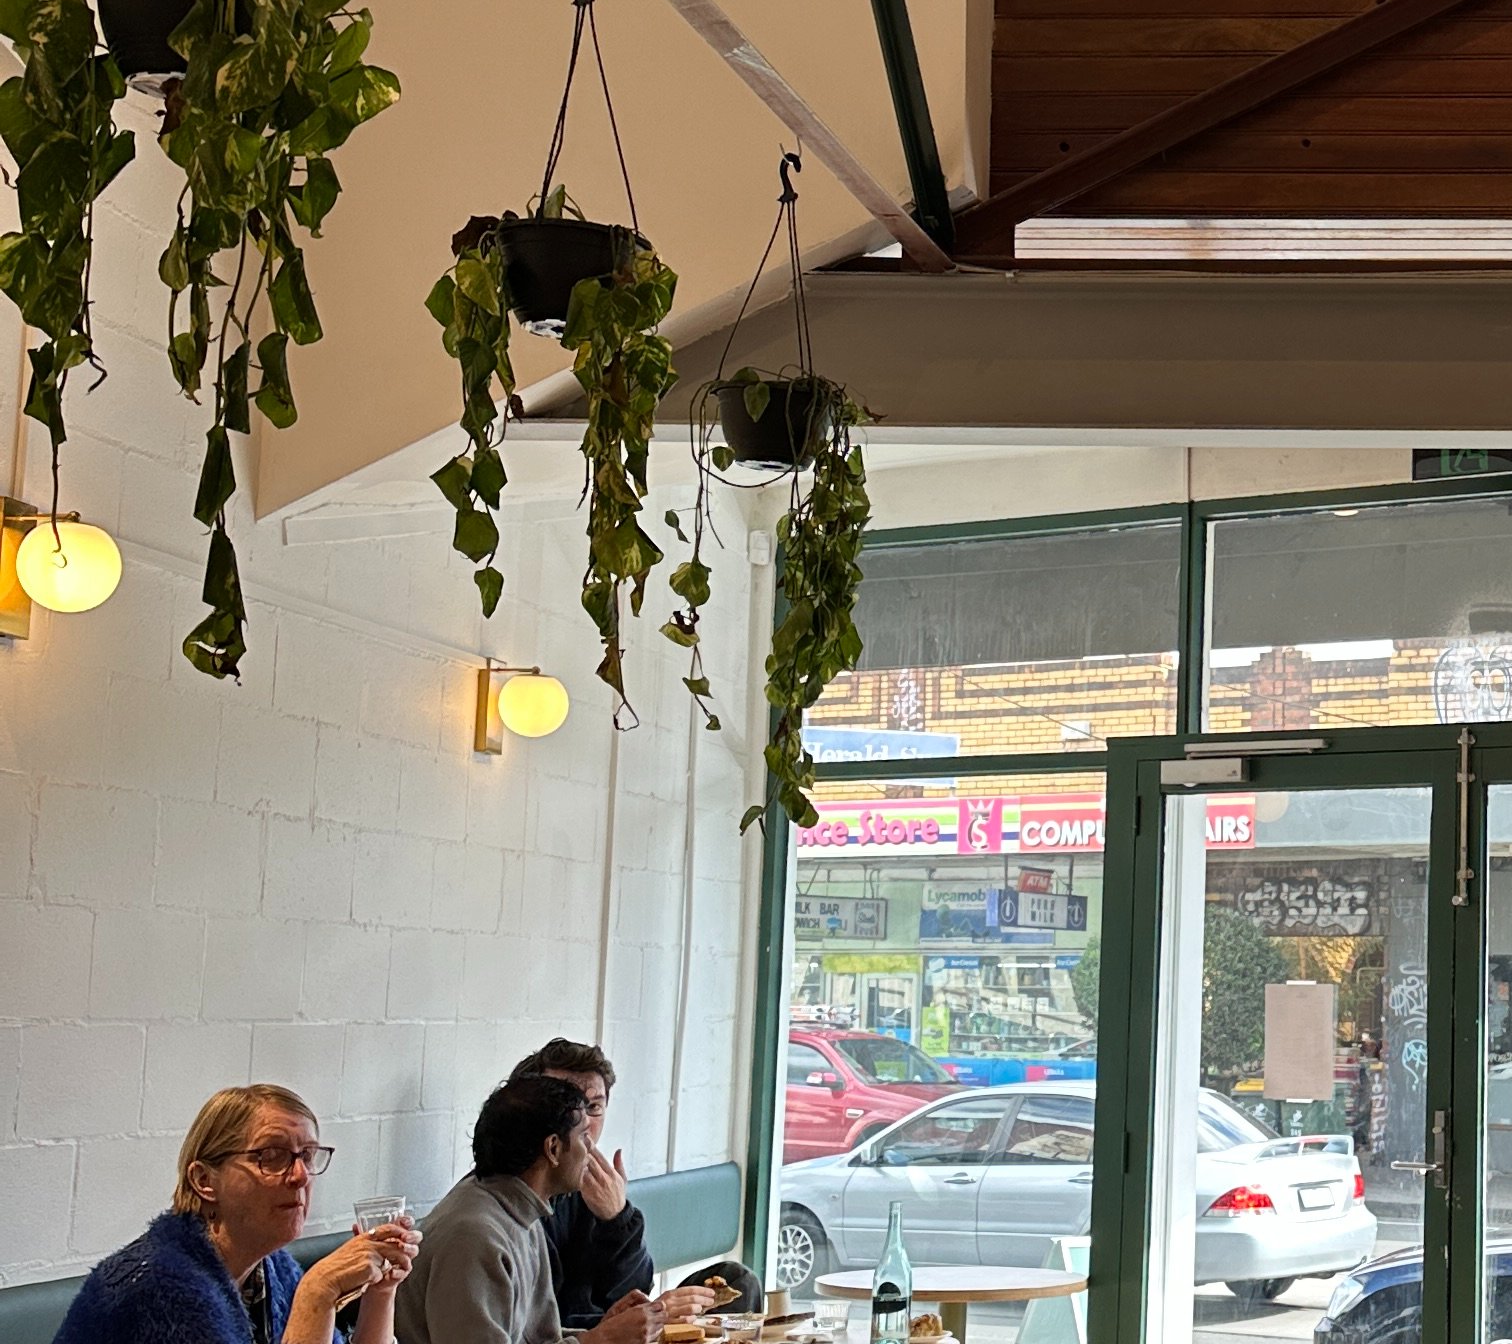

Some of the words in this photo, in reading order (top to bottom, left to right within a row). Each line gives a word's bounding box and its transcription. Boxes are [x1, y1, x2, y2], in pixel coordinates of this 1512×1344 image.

[858, 810, 940, 847] Store
[1026, 875, 1049, 888] ATM
[819, 902, 840, 916] BAR
[1030, 910, 1055, 923] MILK
